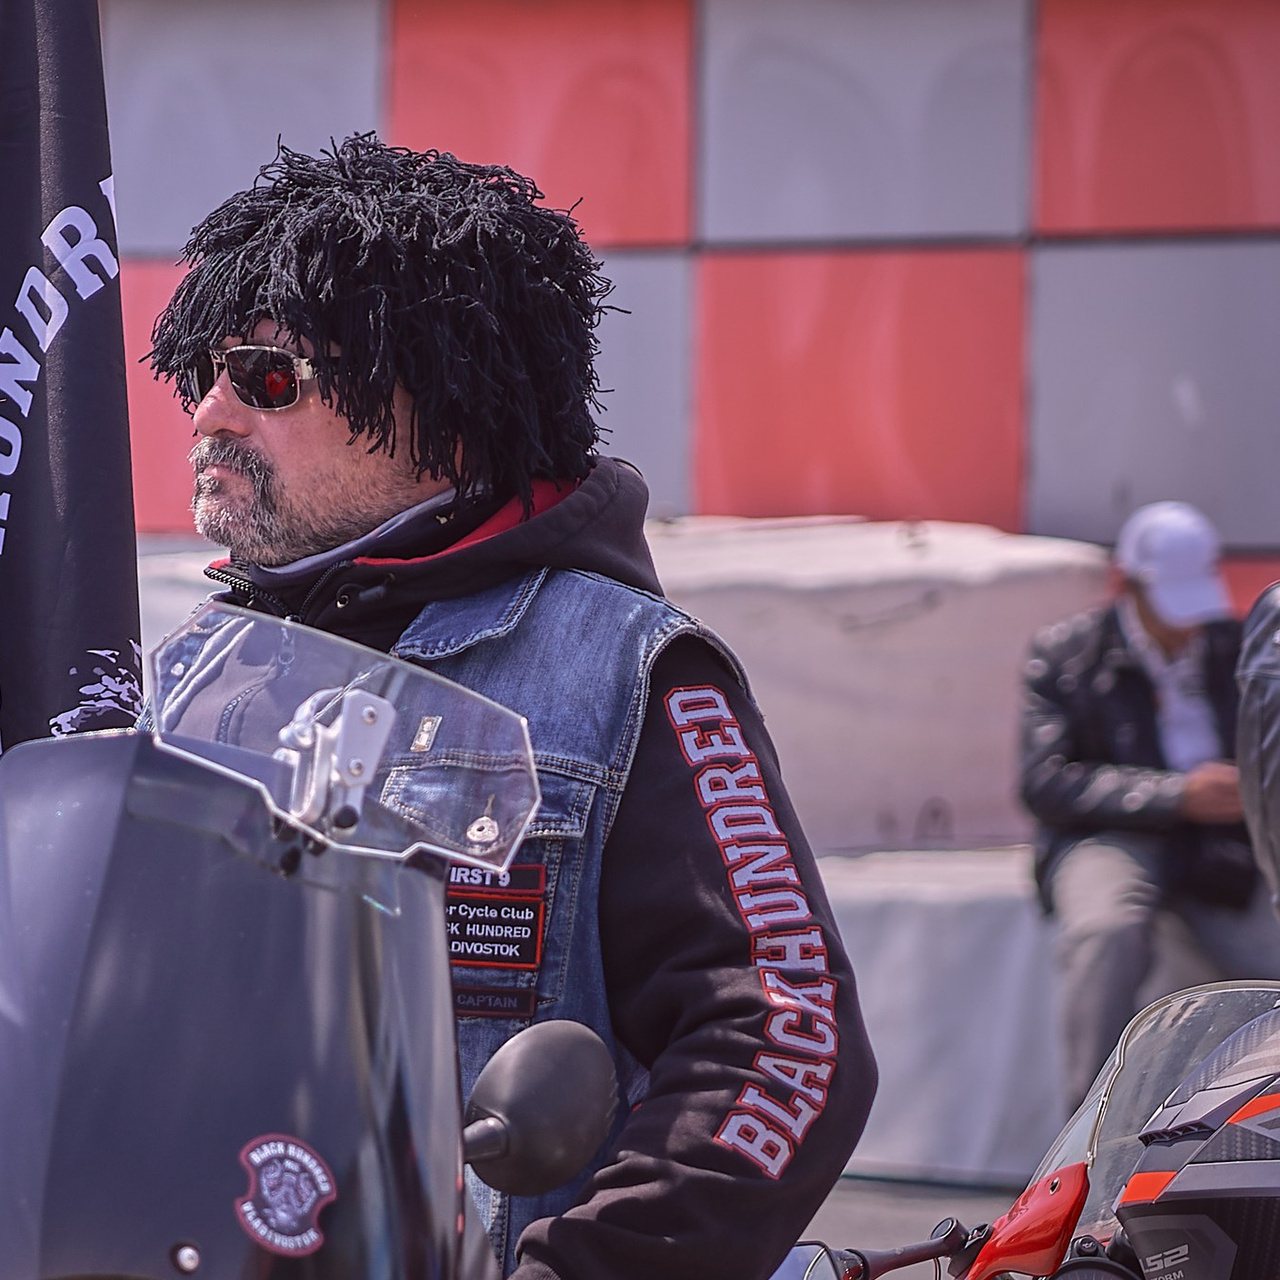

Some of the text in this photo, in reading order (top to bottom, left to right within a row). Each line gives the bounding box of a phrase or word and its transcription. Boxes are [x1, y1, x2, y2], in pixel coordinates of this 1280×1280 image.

[449, 866, 511, 887] IRST 9
[500, 906, 535, 920] Club
[465, 923, 532, 939] HUNDRED
[449, 940, 521, 957] DIVOSTOK
[457, 994, 518, 1008] CAPTAIN
[248, 1141, 286, 1165] BLACK
